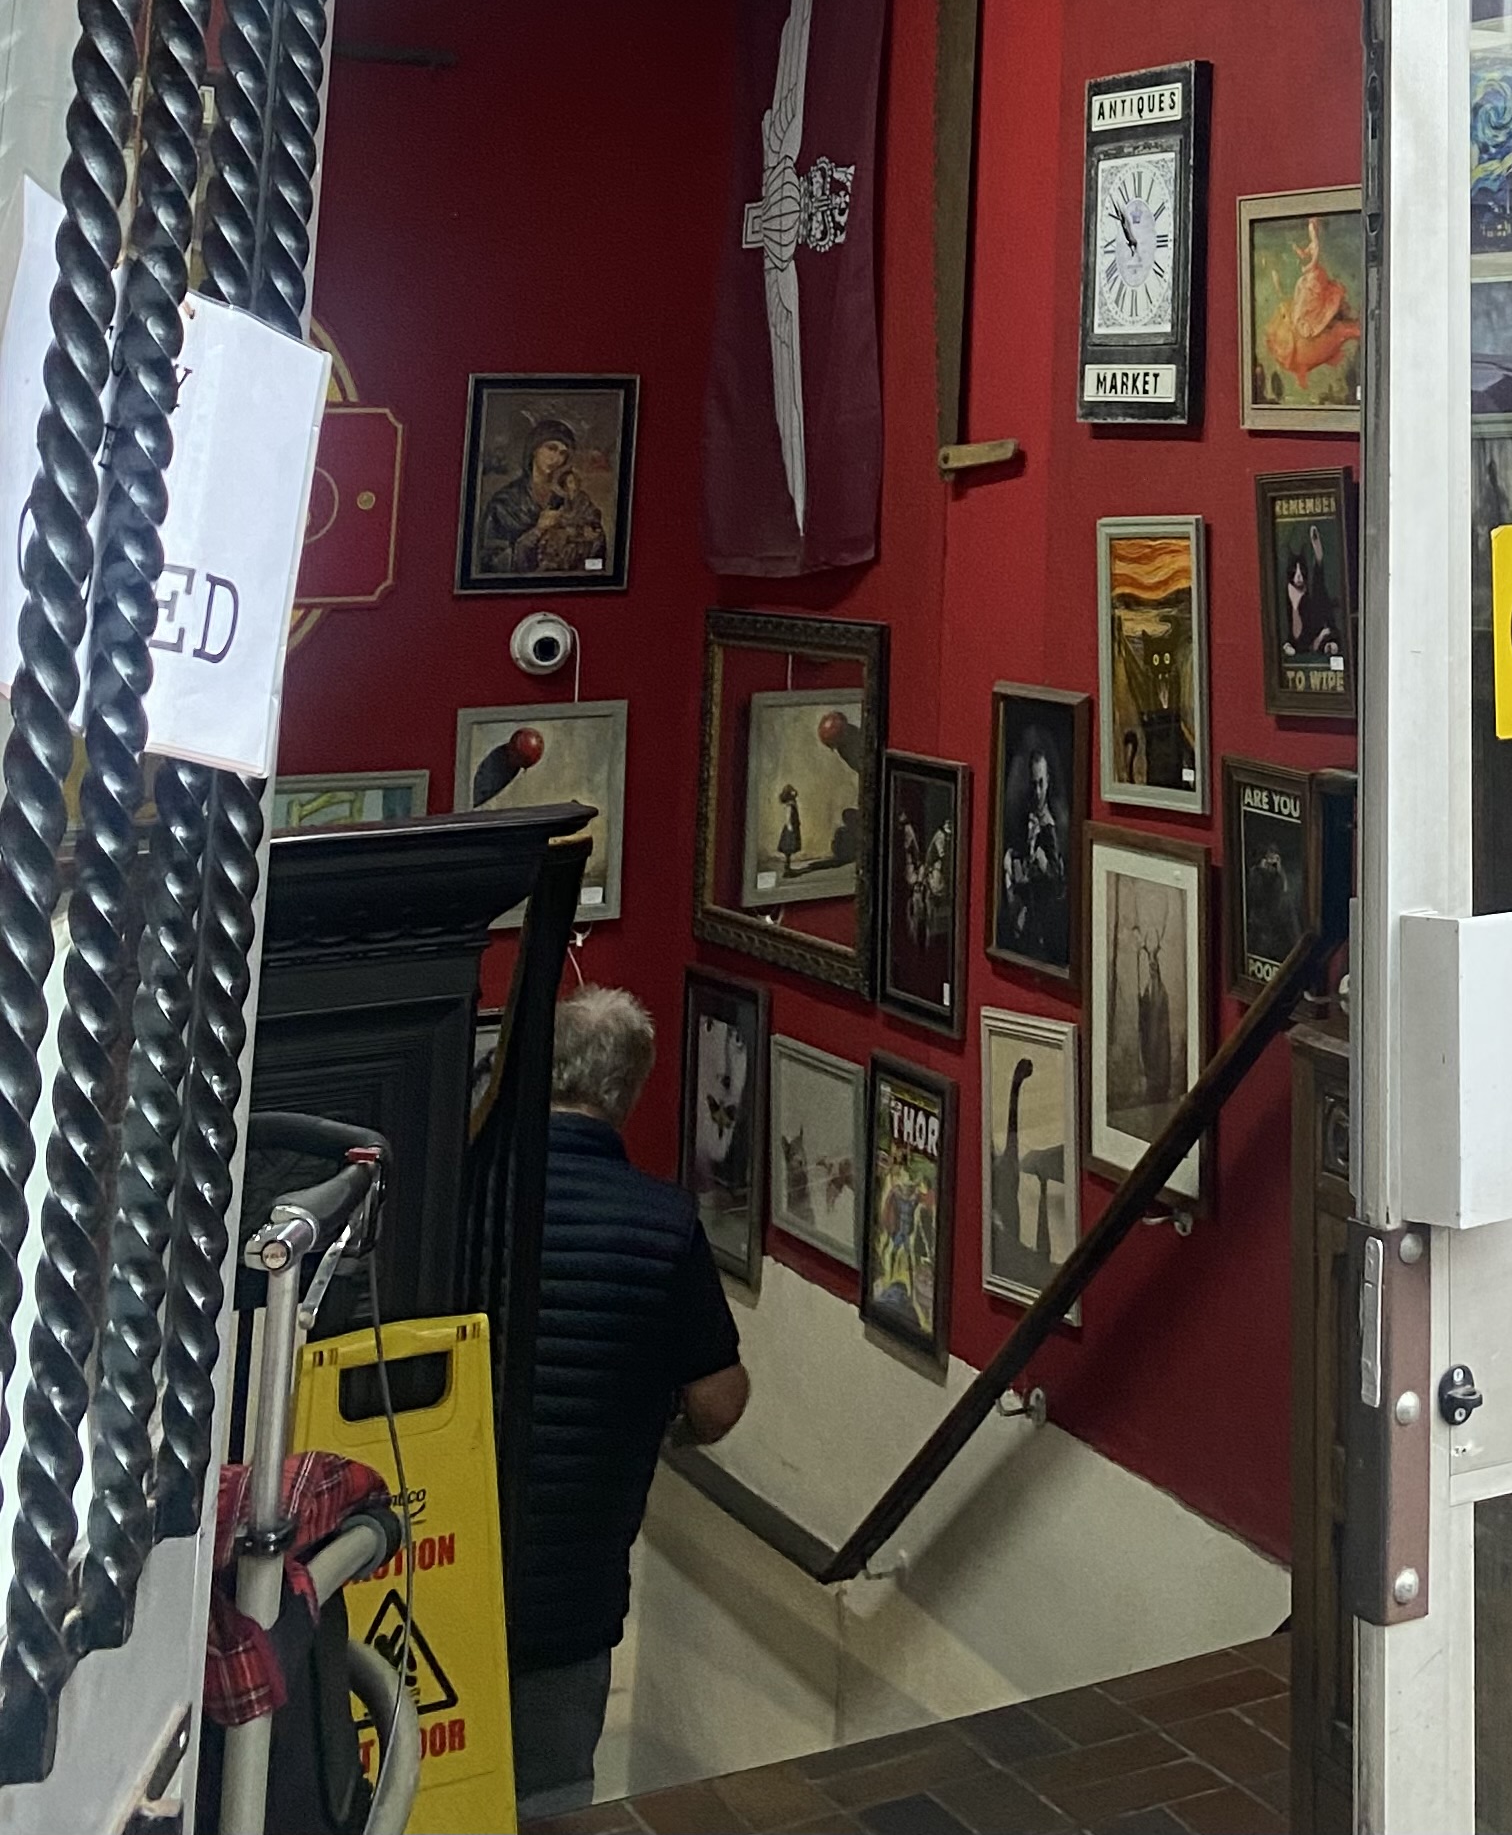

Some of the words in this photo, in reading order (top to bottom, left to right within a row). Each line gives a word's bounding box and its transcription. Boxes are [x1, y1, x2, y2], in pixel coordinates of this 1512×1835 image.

[1097, 91, 1176, 121] ANTIQUES
[1096, 371, 1160, 395] MARKET
[1285, 669, 1306, 692] TO
[1309, 670, 1345, 692] WIPE
[1243, 787, 1270, 810] ARE
[1272, 791, 1300, 818] YOU
[890, 1102, 940, 1157] THOR
